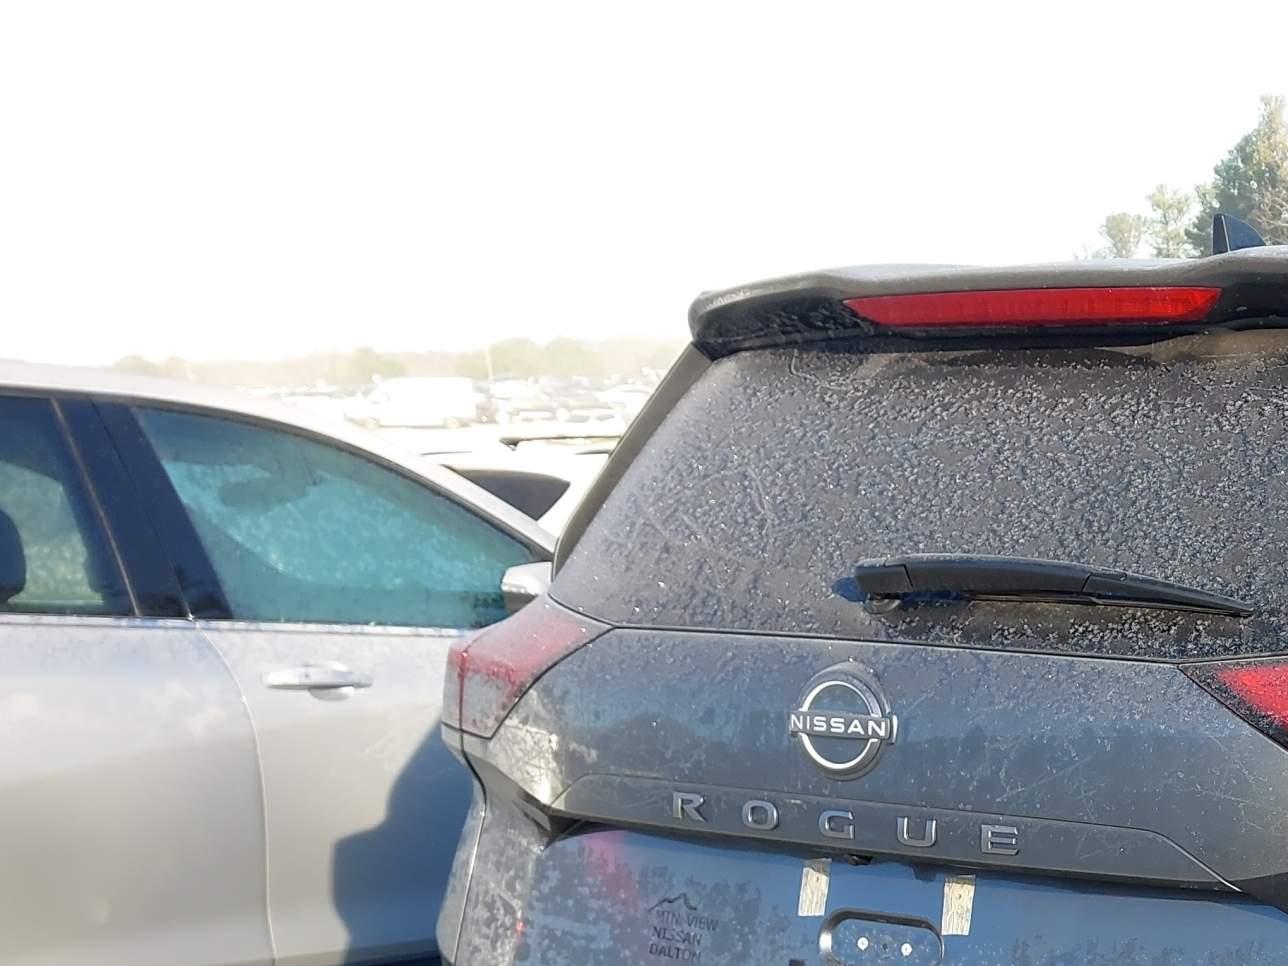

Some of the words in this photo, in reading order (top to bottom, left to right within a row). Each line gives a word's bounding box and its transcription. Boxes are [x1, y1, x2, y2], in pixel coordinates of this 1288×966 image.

[790, 714, 886, 737] NISSAN
[672, 791, 1020, 856] ROGUE
[687, 913, 719, 931] VIEW
[651, 926, 703, 945] NISSAN
[648, 943, 702, 961] DALTON
